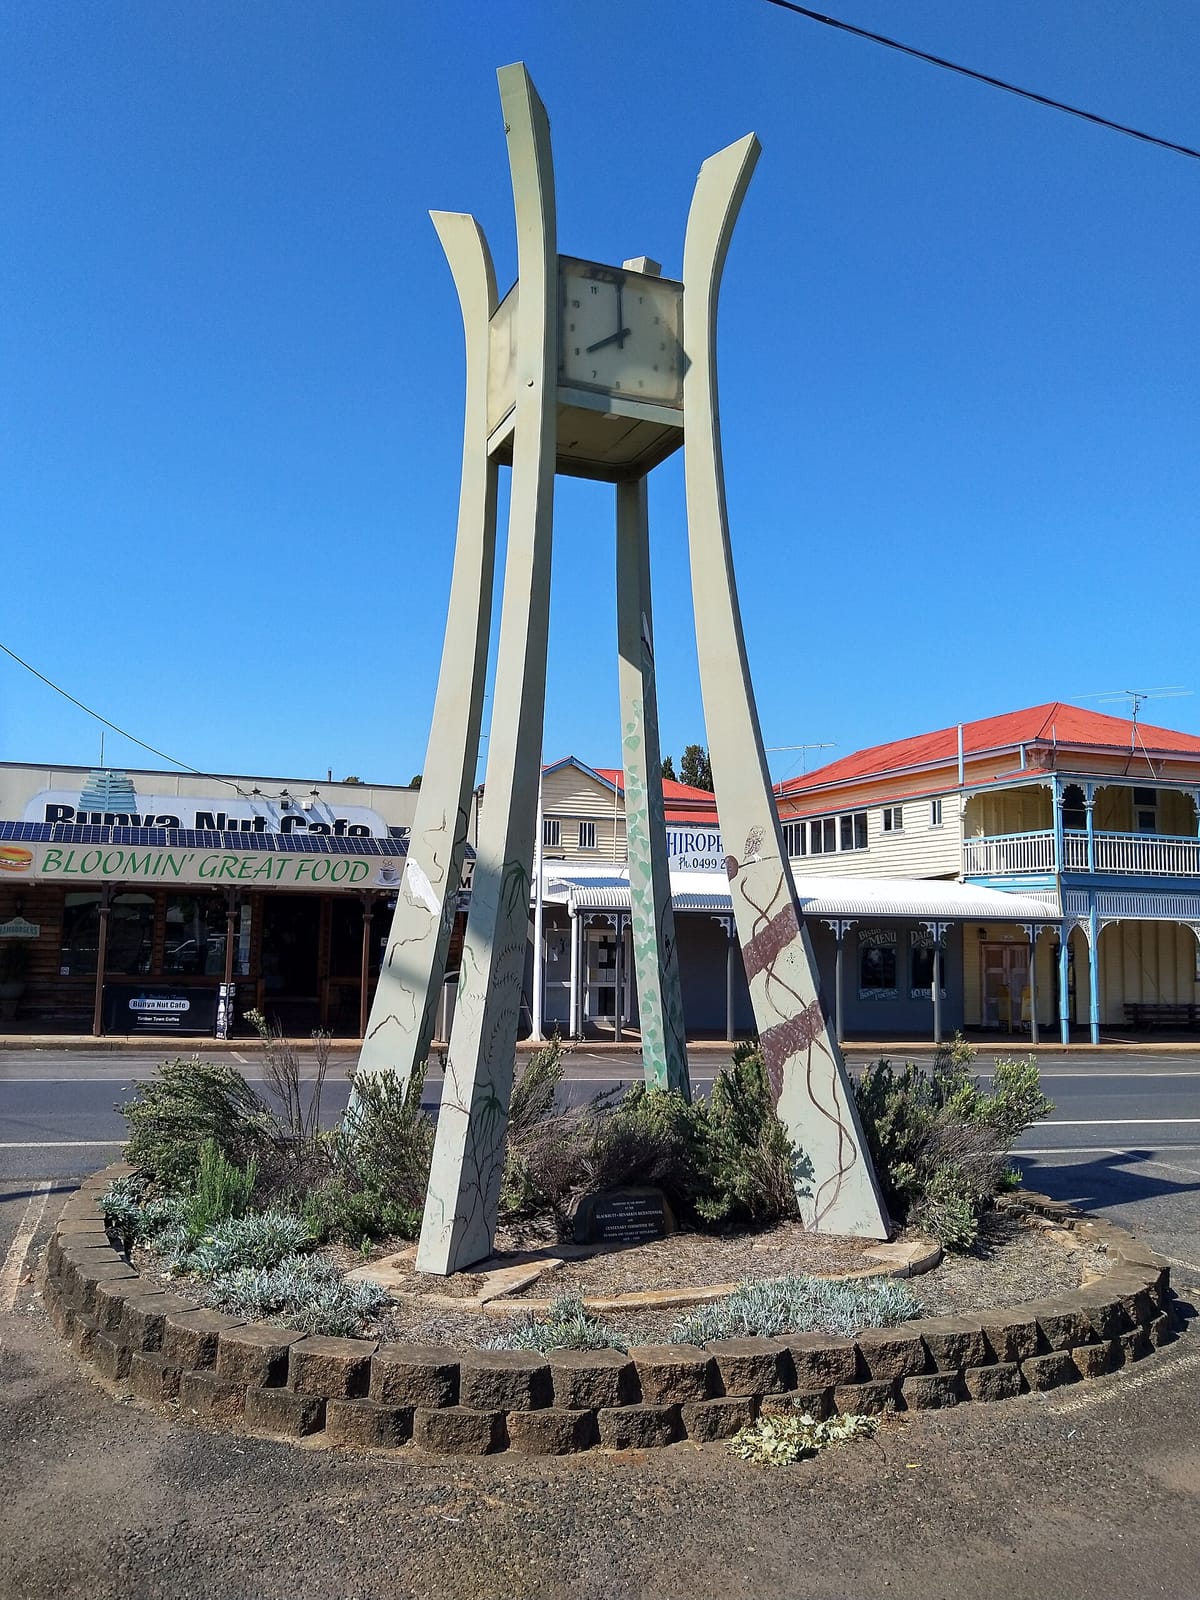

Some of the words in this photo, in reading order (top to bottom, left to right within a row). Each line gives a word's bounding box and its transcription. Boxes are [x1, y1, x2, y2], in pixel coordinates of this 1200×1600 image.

[590, 286, 597, 295] 11
[41, 849, 195, 876] BLOOMIN'
[198, 854, 293, 880] GREAT
[294, 858, 370, 883] FOOD
[692, 858, 717, 869] 0499
[869, 929, 897, 946] MENU
[132, 1000, 155, 1009] Bunya
[170, 1001, 186, 1009] Cafe
